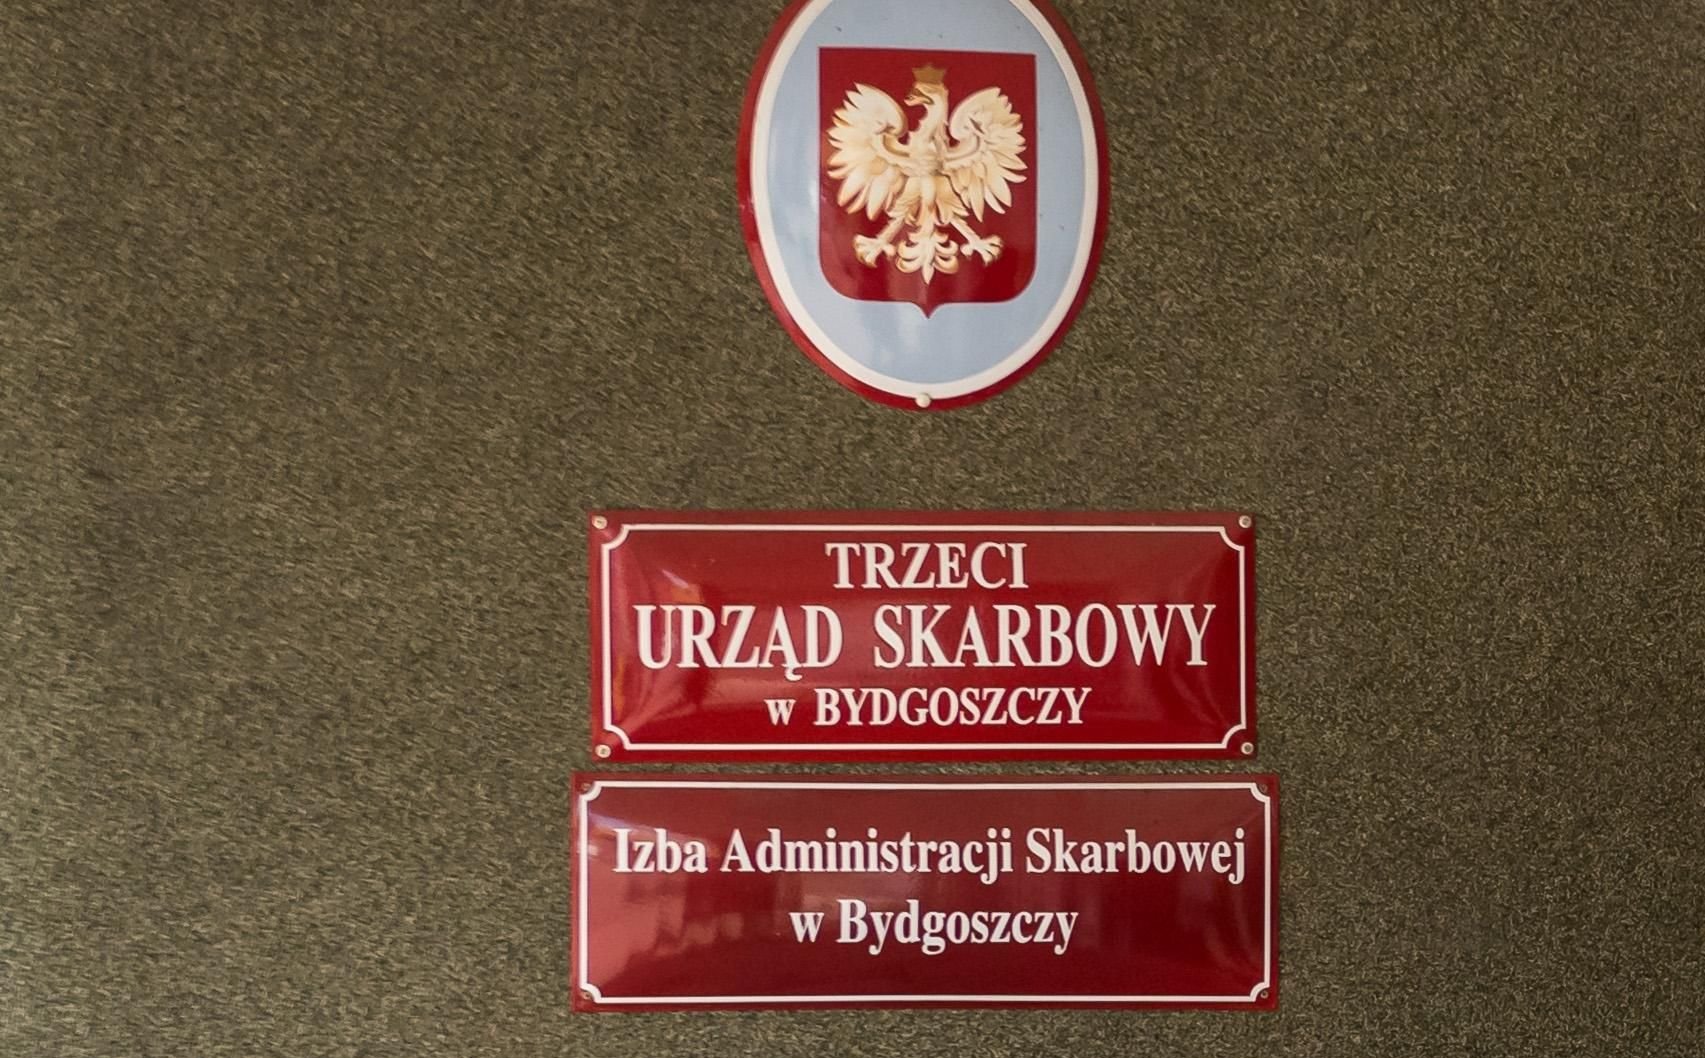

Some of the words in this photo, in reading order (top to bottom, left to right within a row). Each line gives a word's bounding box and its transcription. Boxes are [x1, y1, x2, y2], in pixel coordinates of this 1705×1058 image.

[826, 542, 1027, 590] TRZECI
[634, 604, 843, 681] URZĄD
[873, 603, 1216, 669] SKARBOWY
[764, 698, 796, 725] w
[814, 687, 1091, 727] BYDGOSZCZY
[612, 828, 708, 873] Izba
[719, 827, 1013, 884] Administracji
[1025, 828, 1245, 884] Skarbowej
[789, 910, 824, 943] w
[836, 898, 1078, 954] Bydgoszczy
